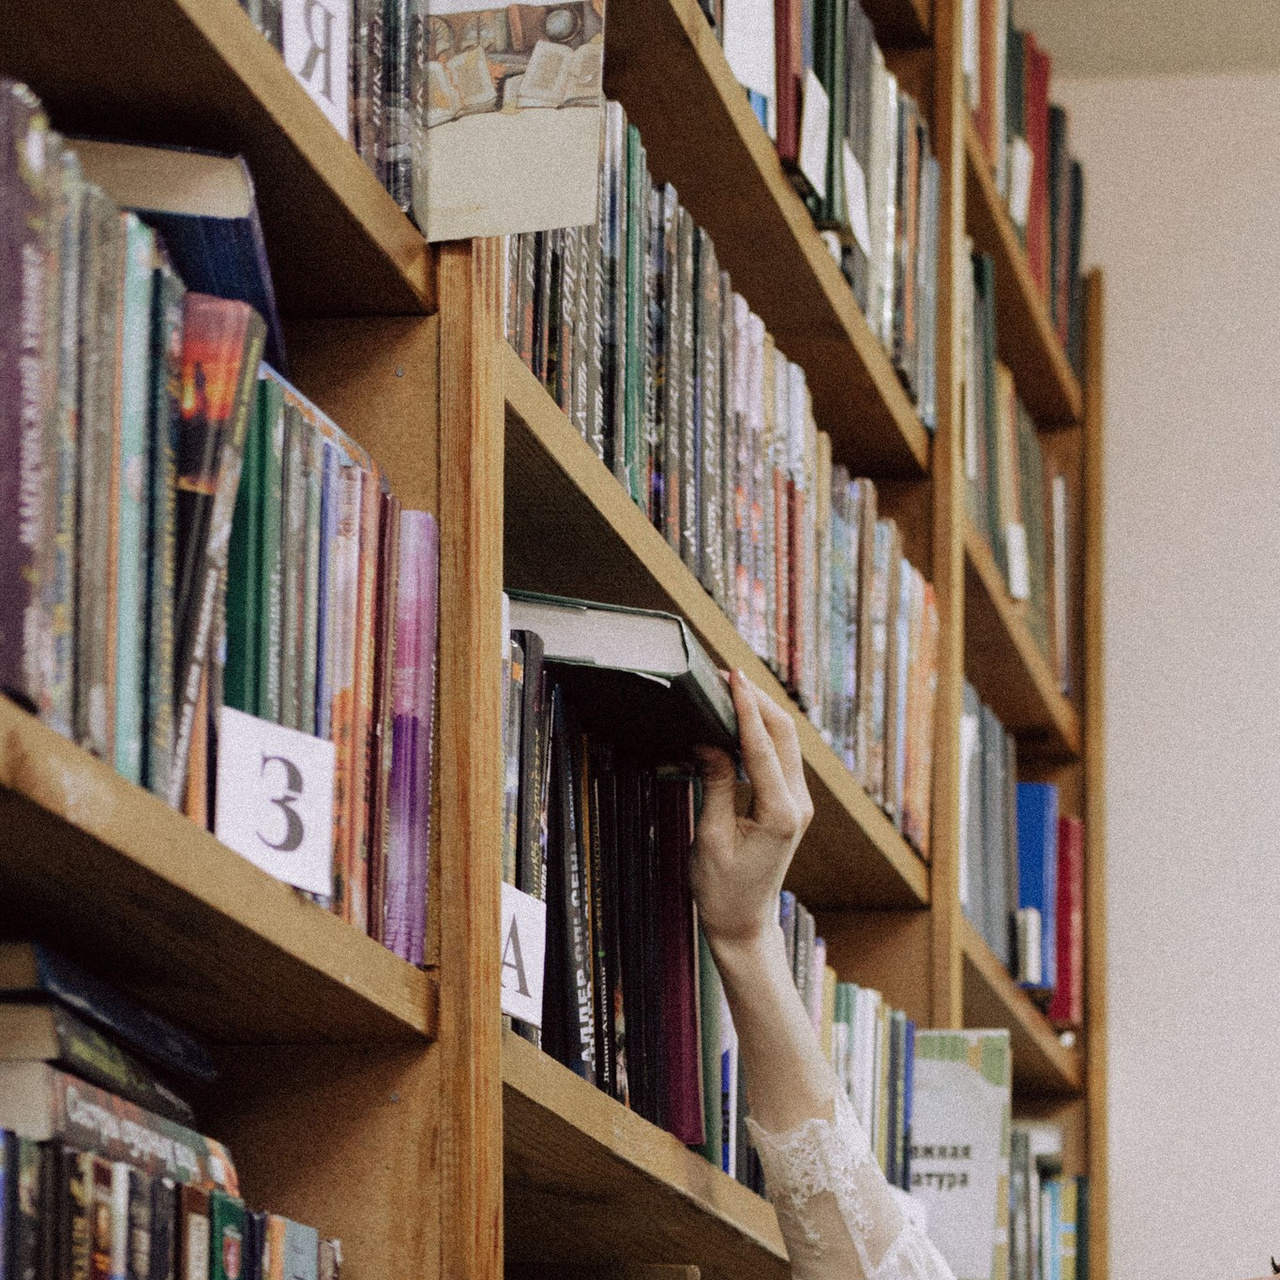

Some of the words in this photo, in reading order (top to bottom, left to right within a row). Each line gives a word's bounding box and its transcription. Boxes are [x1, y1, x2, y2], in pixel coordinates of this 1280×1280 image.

[301, 0, 337, 105] Я
[255, 750, 305, 852] З
[500, 912, 532, 999] А
